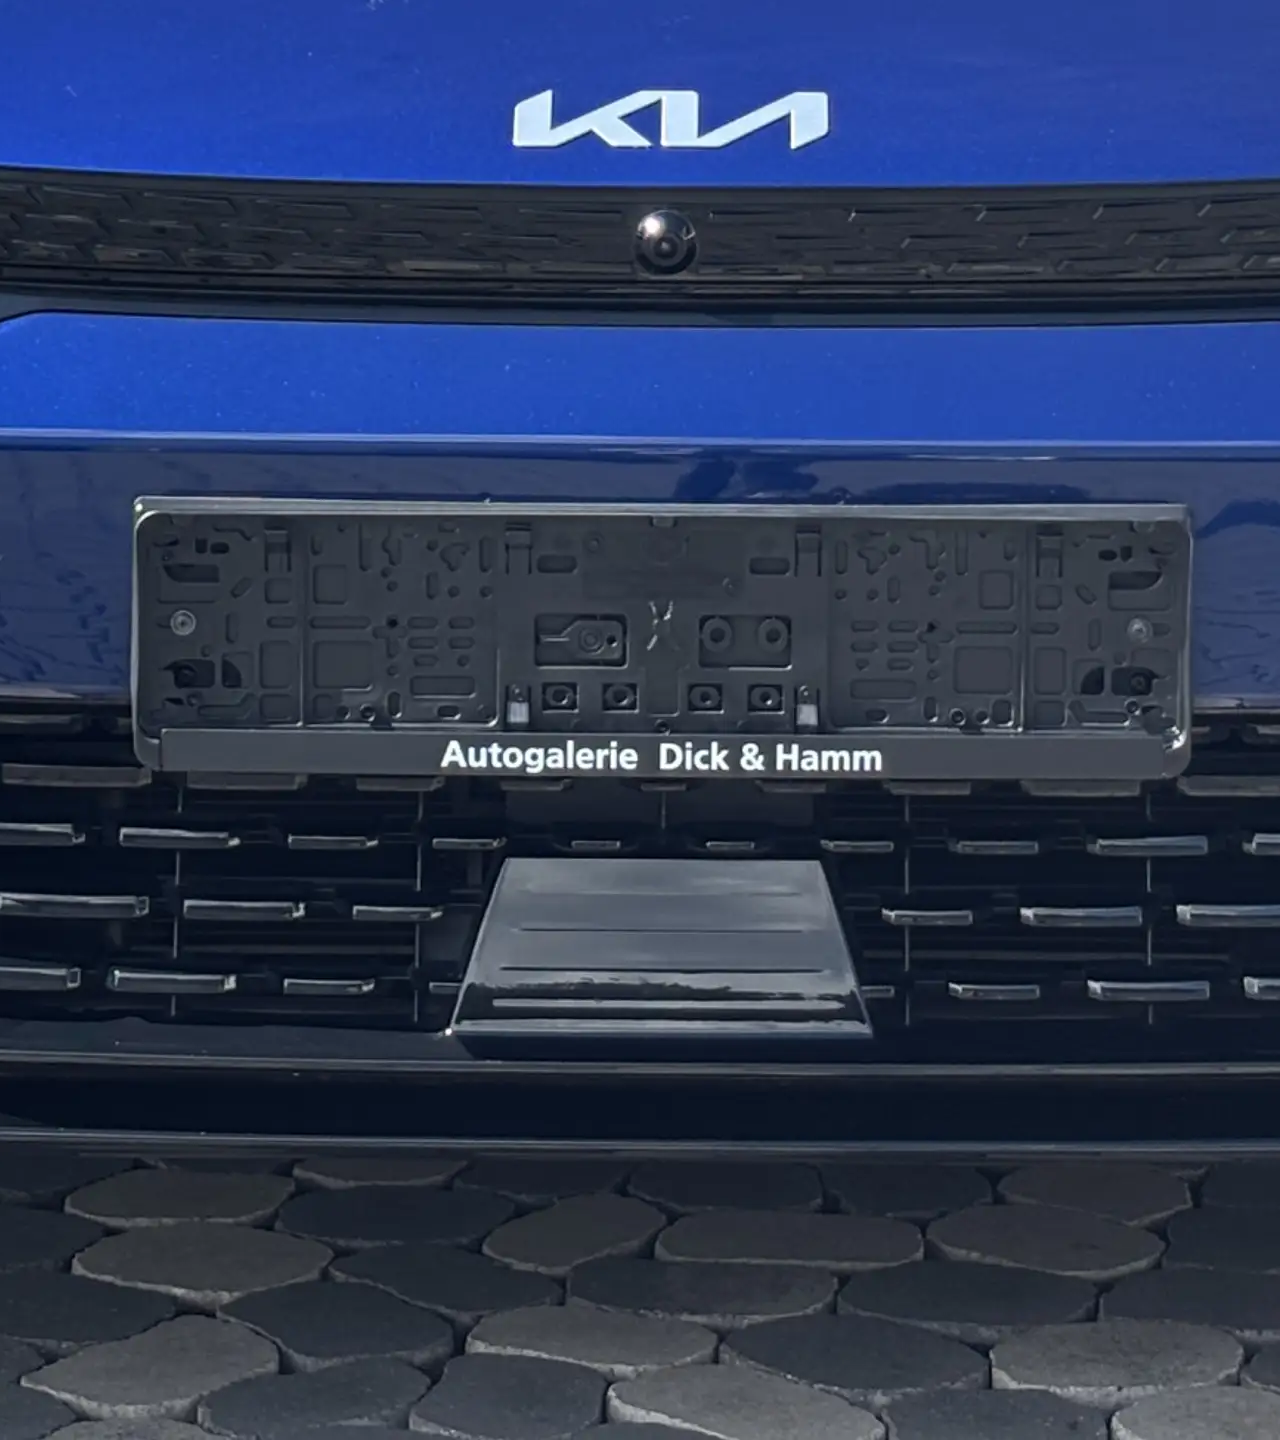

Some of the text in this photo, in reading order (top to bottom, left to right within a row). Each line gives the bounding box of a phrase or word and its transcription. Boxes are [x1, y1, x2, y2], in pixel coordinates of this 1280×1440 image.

[512, 89, 830, 151] KIA
[440, 739, 883, 775] Autogalerie Dick & Hamm
